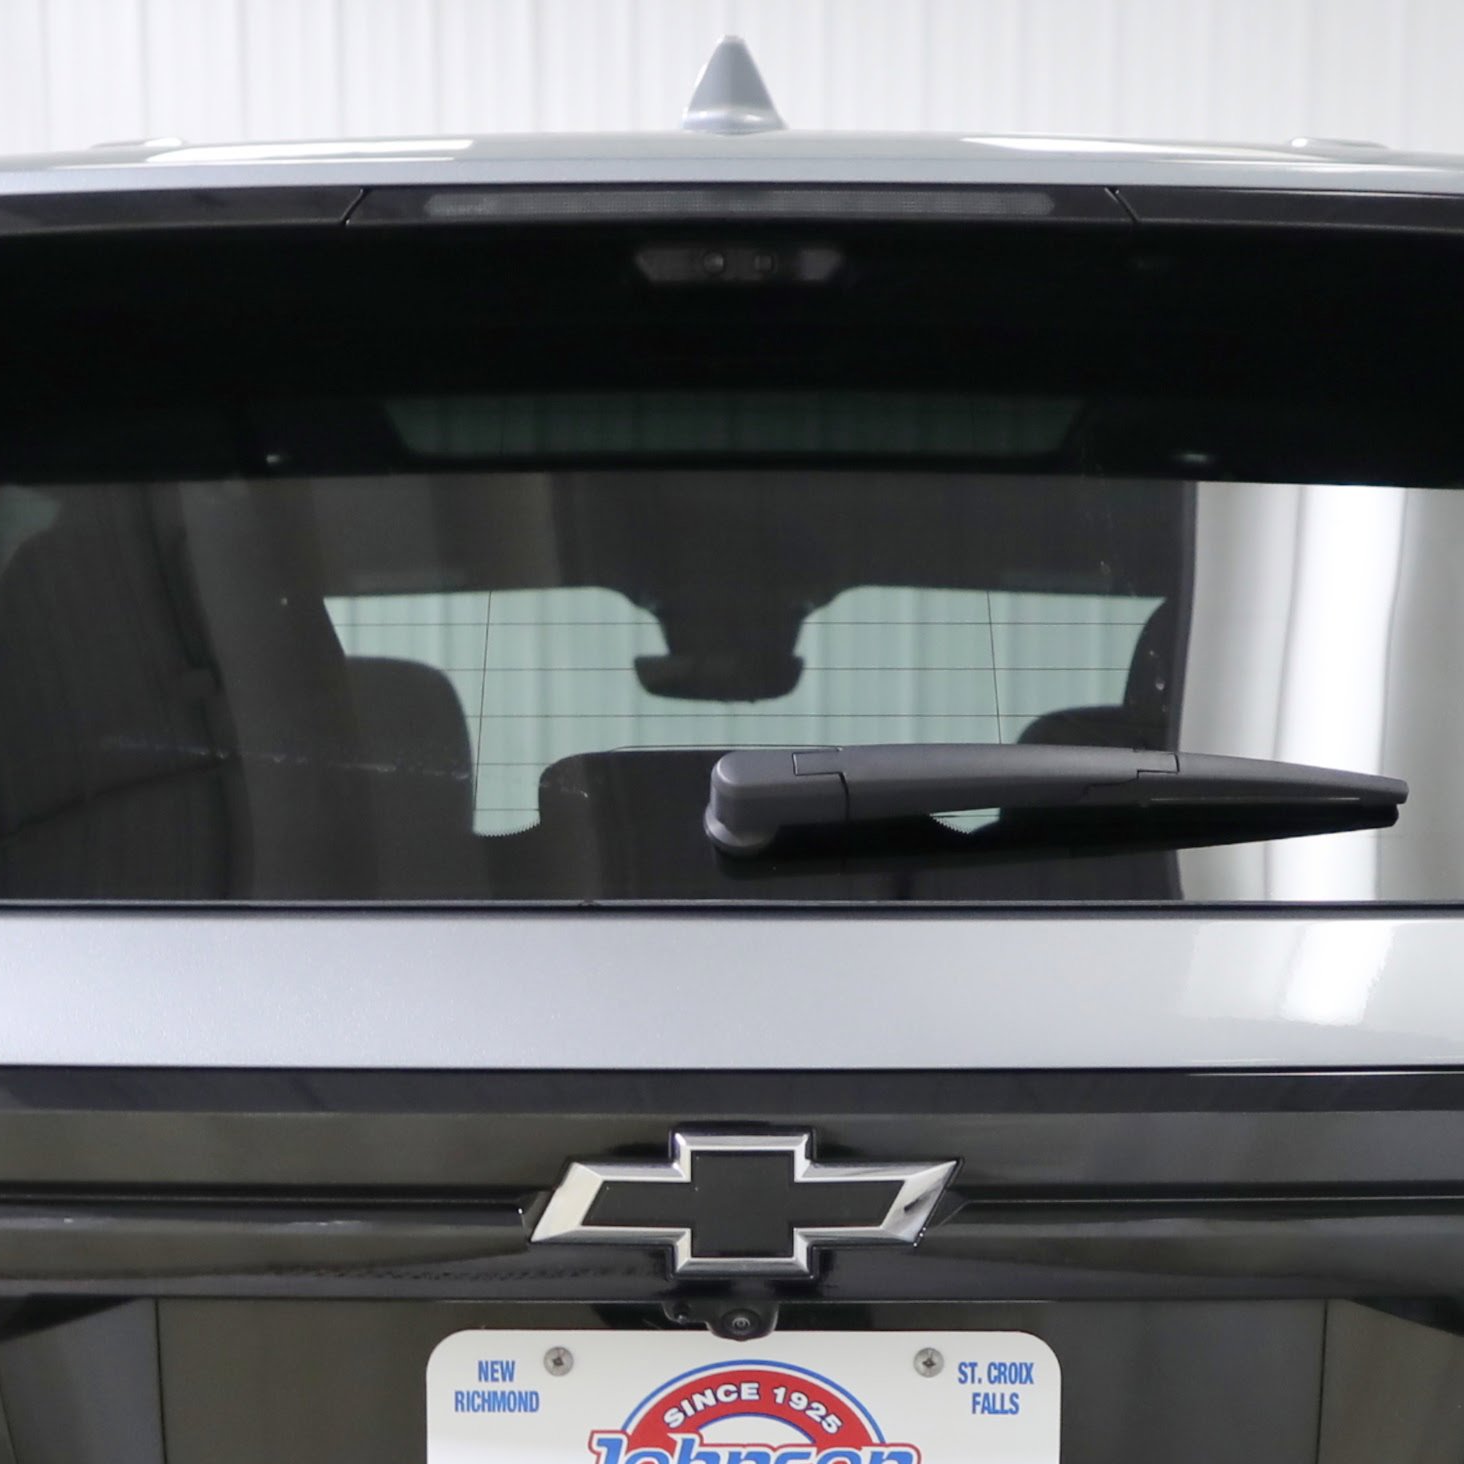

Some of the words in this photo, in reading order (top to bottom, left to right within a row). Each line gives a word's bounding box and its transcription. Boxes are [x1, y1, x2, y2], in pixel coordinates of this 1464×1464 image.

[477, 1360, 516, 1383] NEW
[957, 1361, 982, 1384] ST.
[986, 1361, 1034, 1385] CROIX
[454, 1390, 540, 1413] RICHMOND
[663, 1382, 761, 1429] SINCE
[772, 1385, 844, 1435] 1925
[971, 1392, 1020, 1415] FALLS
